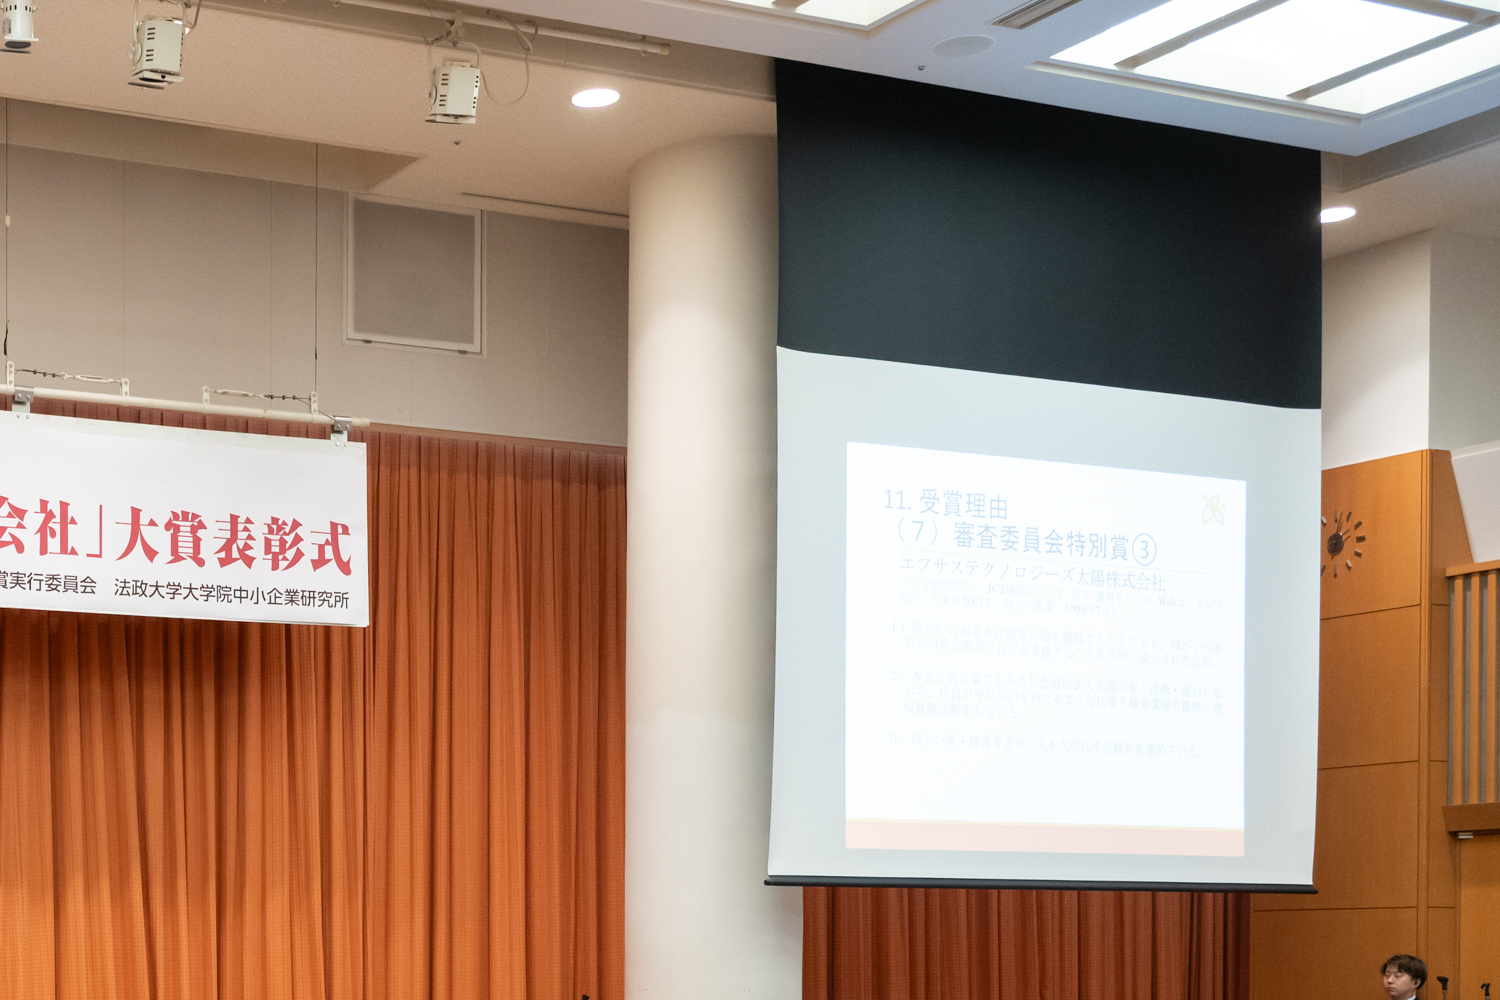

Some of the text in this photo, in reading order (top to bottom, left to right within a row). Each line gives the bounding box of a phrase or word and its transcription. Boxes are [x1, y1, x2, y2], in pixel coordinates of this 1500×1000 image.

[920, 487, 1008, 521] 受賞理由
[899, 556, 1167, 592] エフサステクノロジーズ太陽株式会社
[113, 581, 350, 610] 法政大学大学院中小企業研究所
